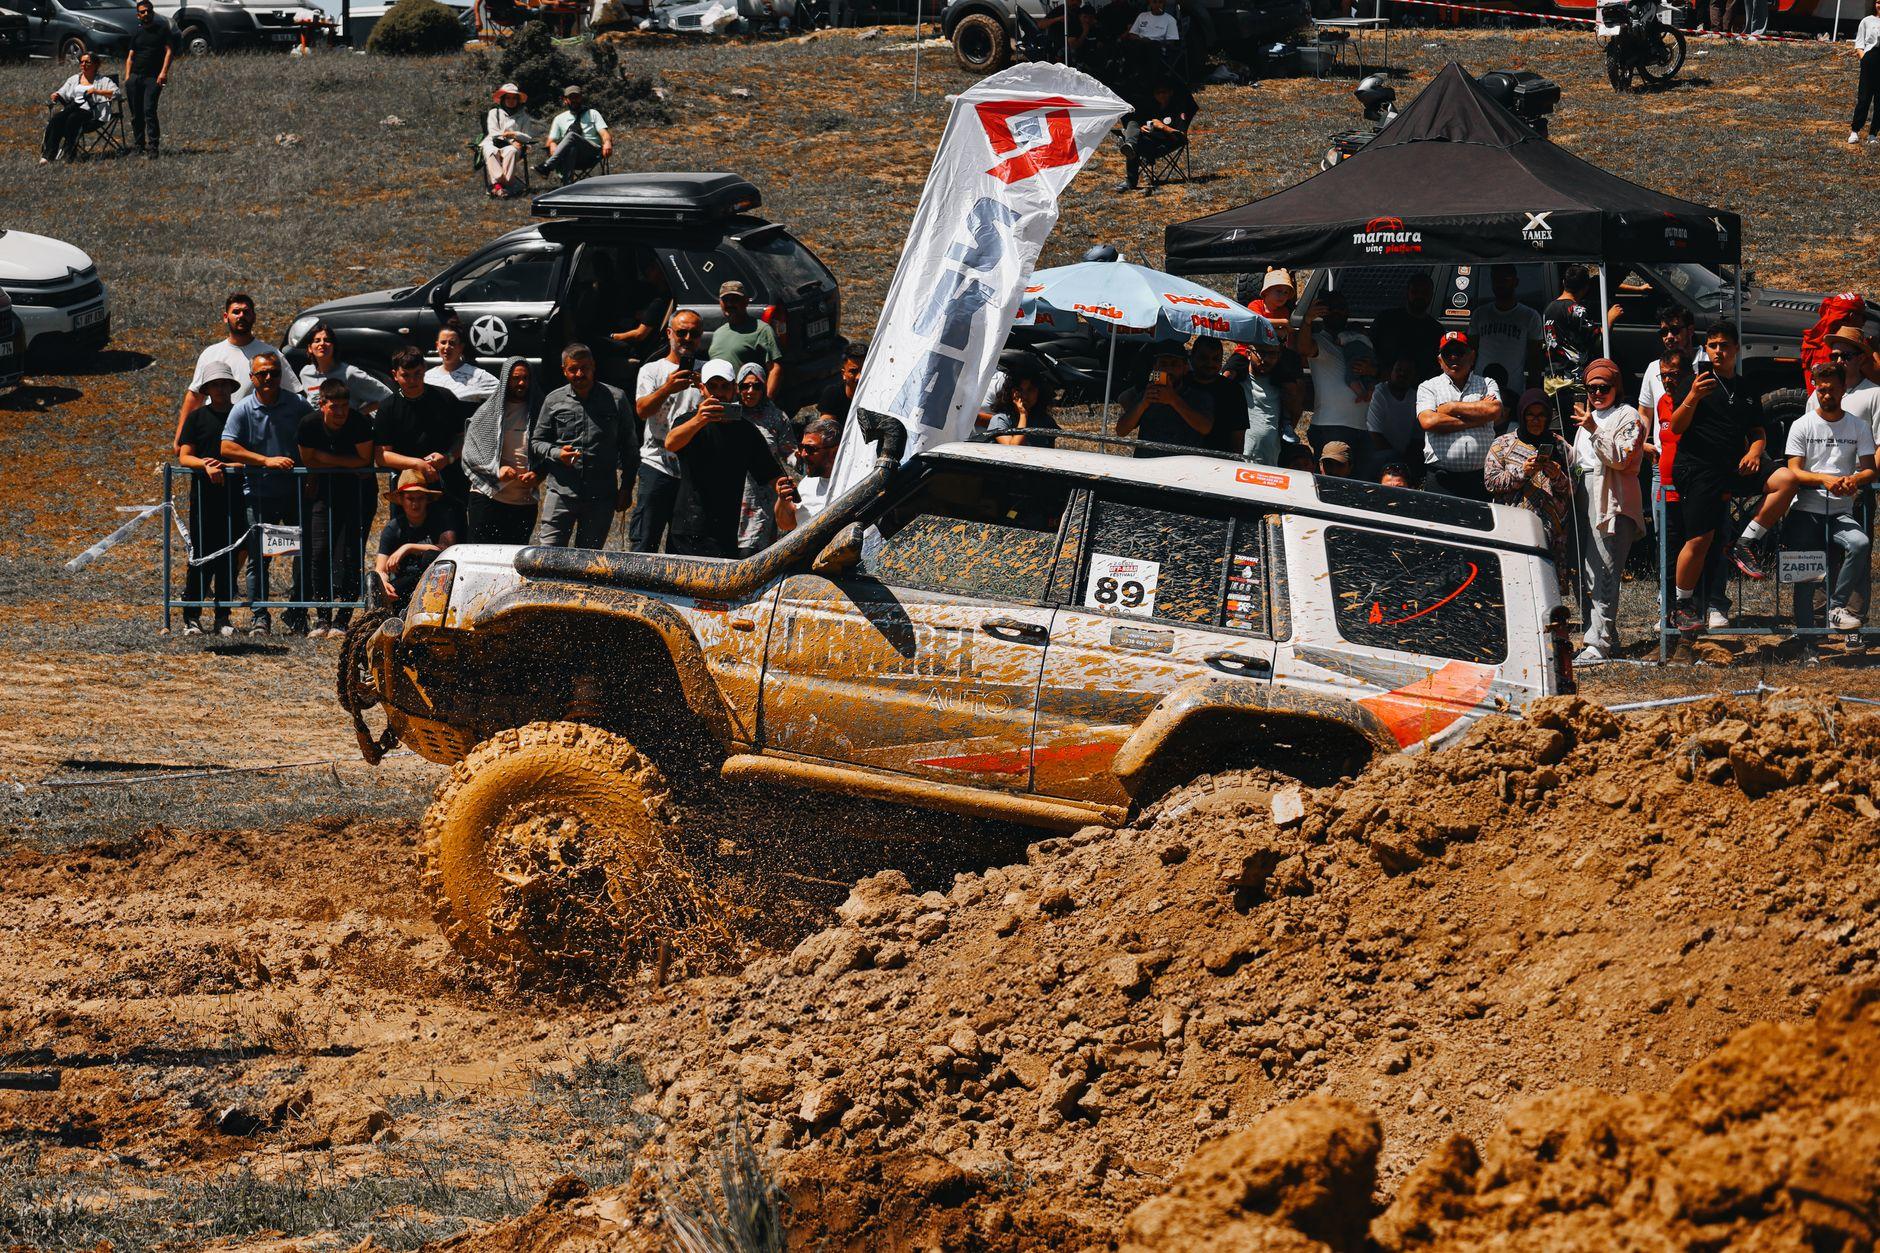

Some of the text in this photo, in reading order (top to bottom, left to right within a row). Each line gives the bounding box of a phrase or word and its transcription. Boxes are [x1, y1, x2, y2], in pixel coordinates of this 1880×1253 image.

[1353, 231, 1422, 245] marmara
[1522, 230, 1552, 240] YAMEX
[1366, 244, 1422, 254] vinç platform
[1163, 293, 1231, 309] panda
[1073, 303, 1123, 319] panda
[1190, 313, 1230, 332] panda
[267, 538, 295, 547] ZABITA
[1782, 563, 1825, 571] ZABITA
[1094, 577, 1145, 608] 89
[924, 686, 1012, 715] AUTO
